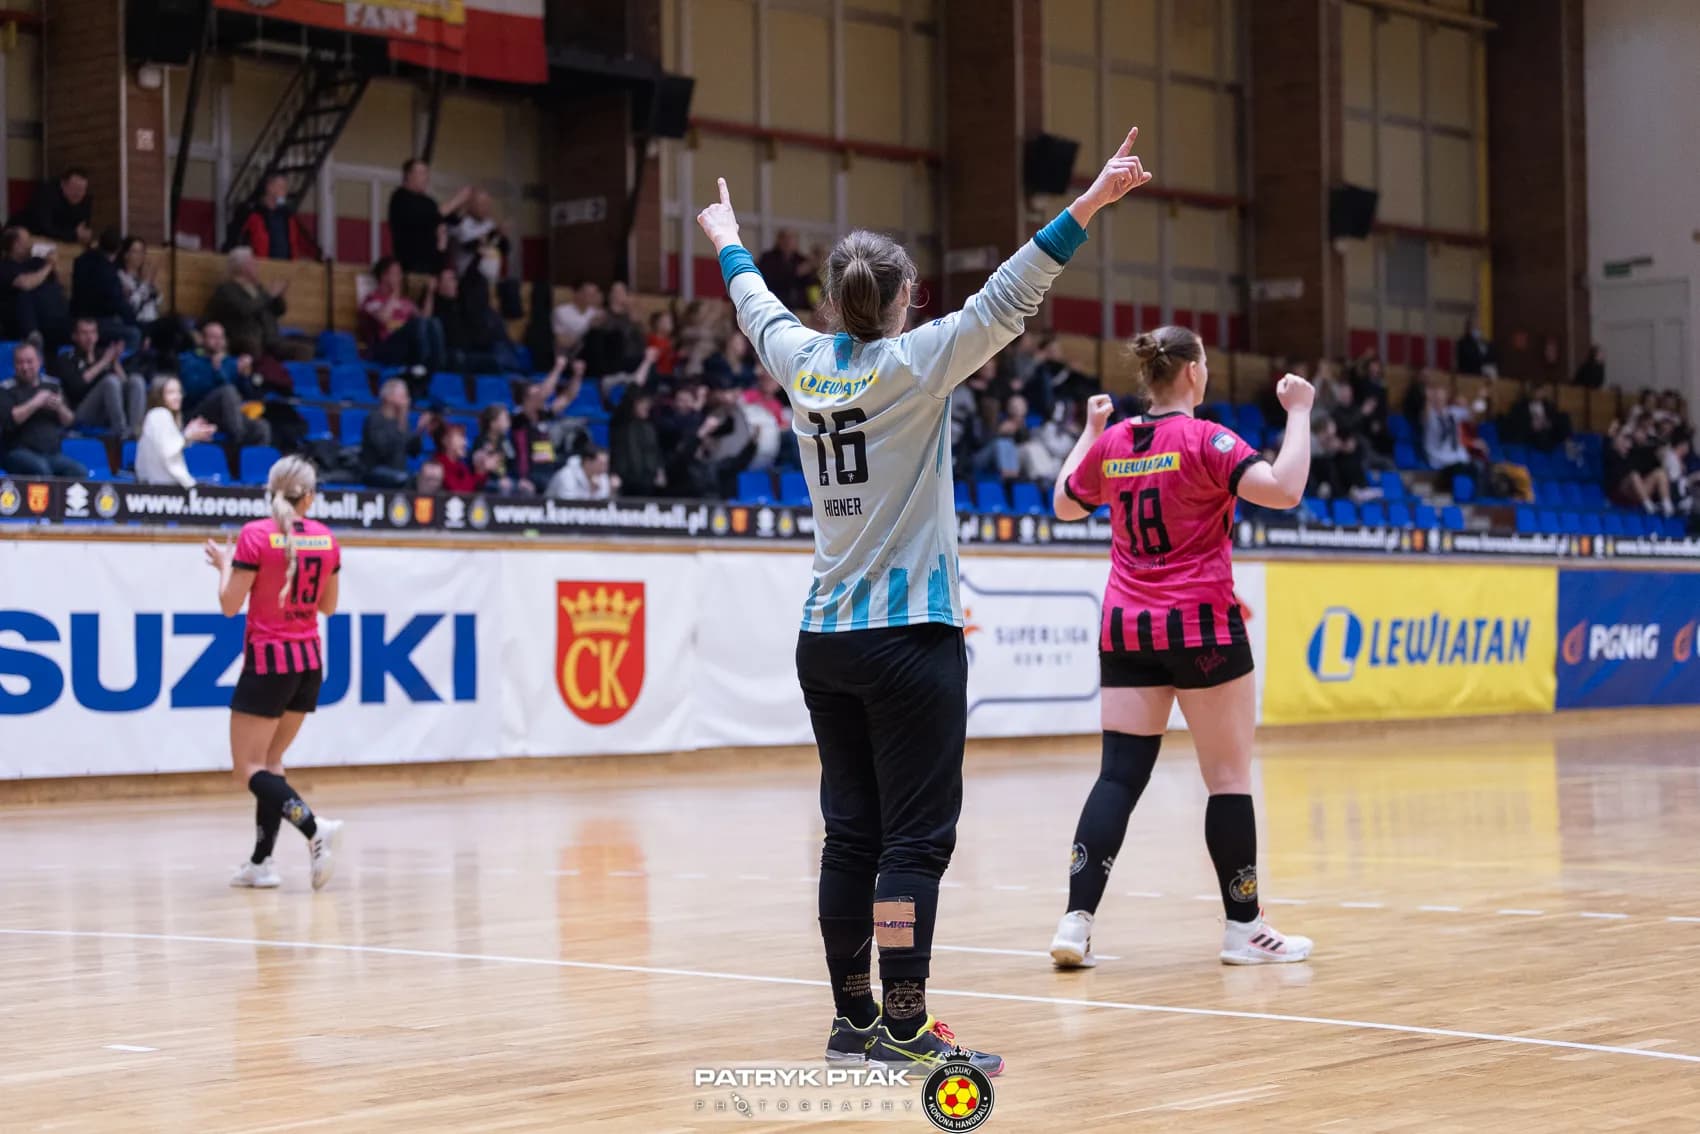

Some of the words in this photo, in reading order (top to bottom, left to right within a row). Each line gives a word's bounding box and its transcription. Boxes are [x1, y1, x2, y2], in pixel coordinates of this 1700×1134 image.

[808, 407, 869, 486] 16
[1119, 455, 1174, 474] LEWIATAN
[824, 497, 862, 517] HIBNER
[1120, 488, 1172, 557] 18
[290, 556, 322, 604] 13
[1369, 612, 1531, 667] LEWIATAN
[562, 638, 629, 710] CK
